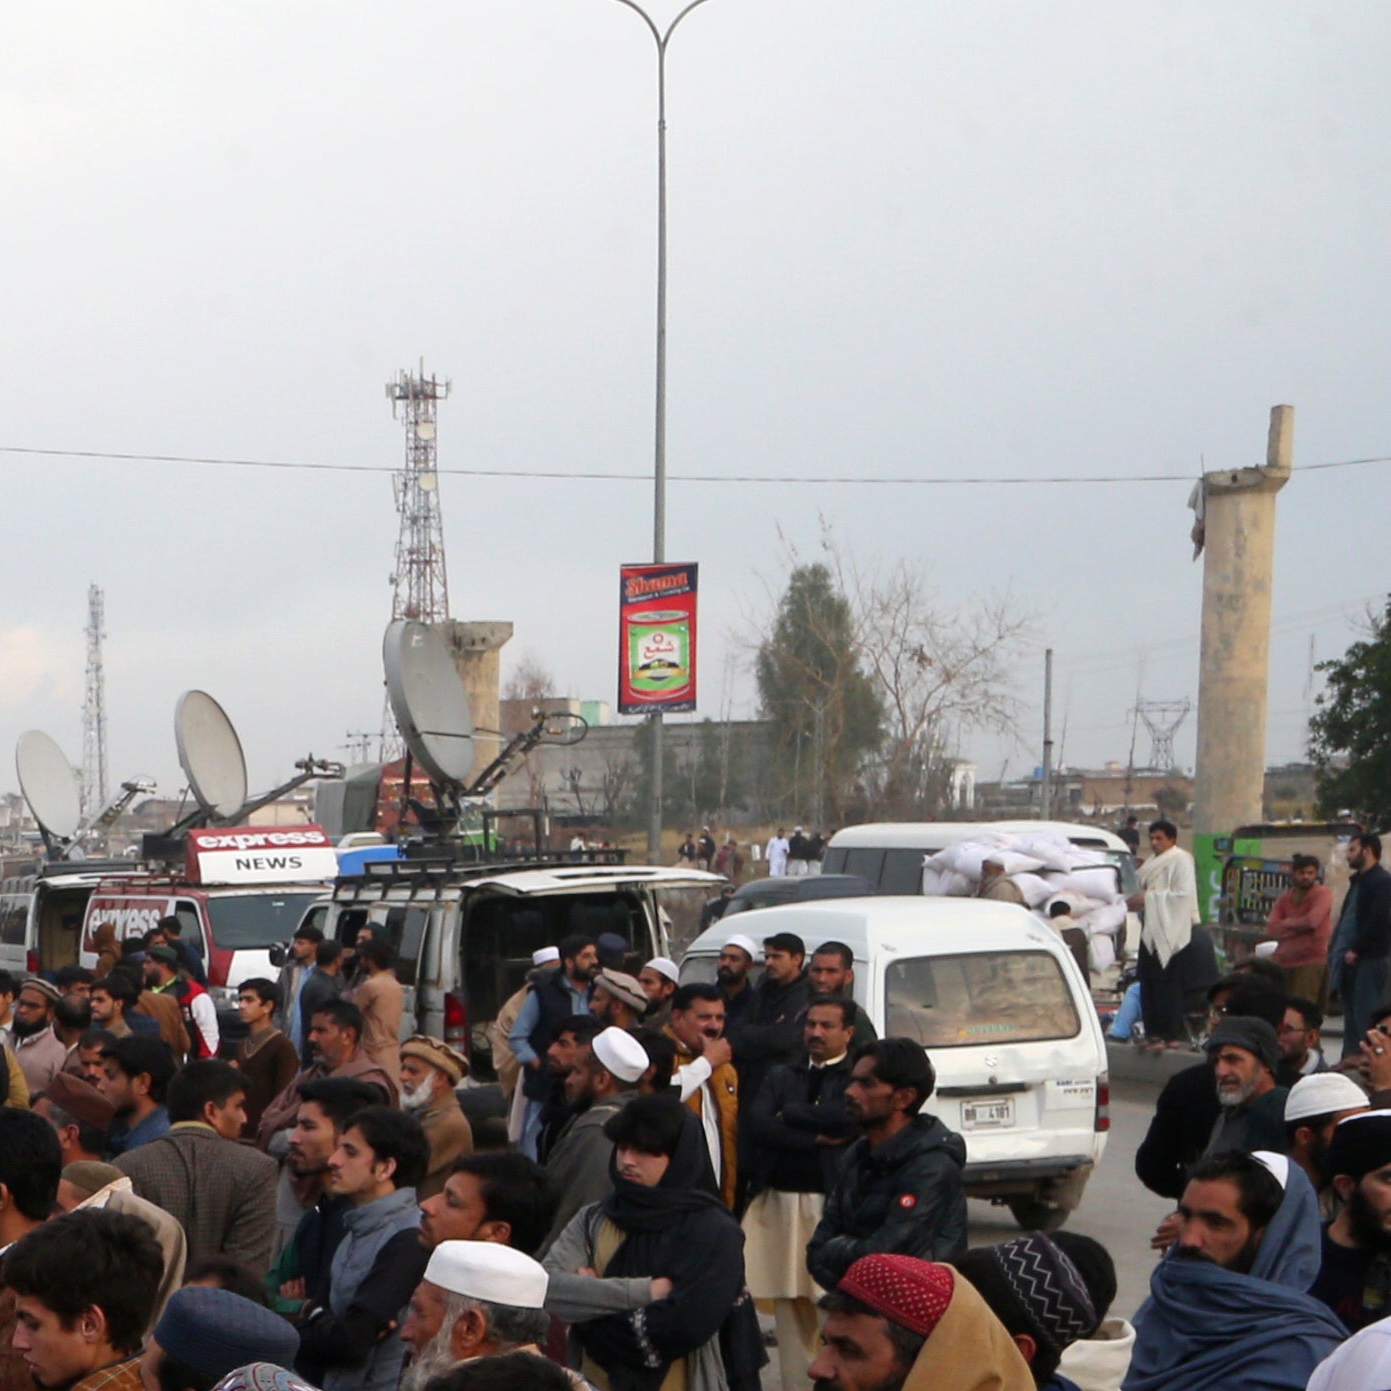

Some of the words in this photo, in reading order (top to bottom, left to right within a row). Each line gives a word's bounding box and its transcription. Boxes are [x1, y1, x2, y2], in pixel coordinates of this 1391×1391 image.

[626, 573, 688, 596] Shama
[197, 831, 325, 849] express
[236, 855, 303, 871] NEWS
